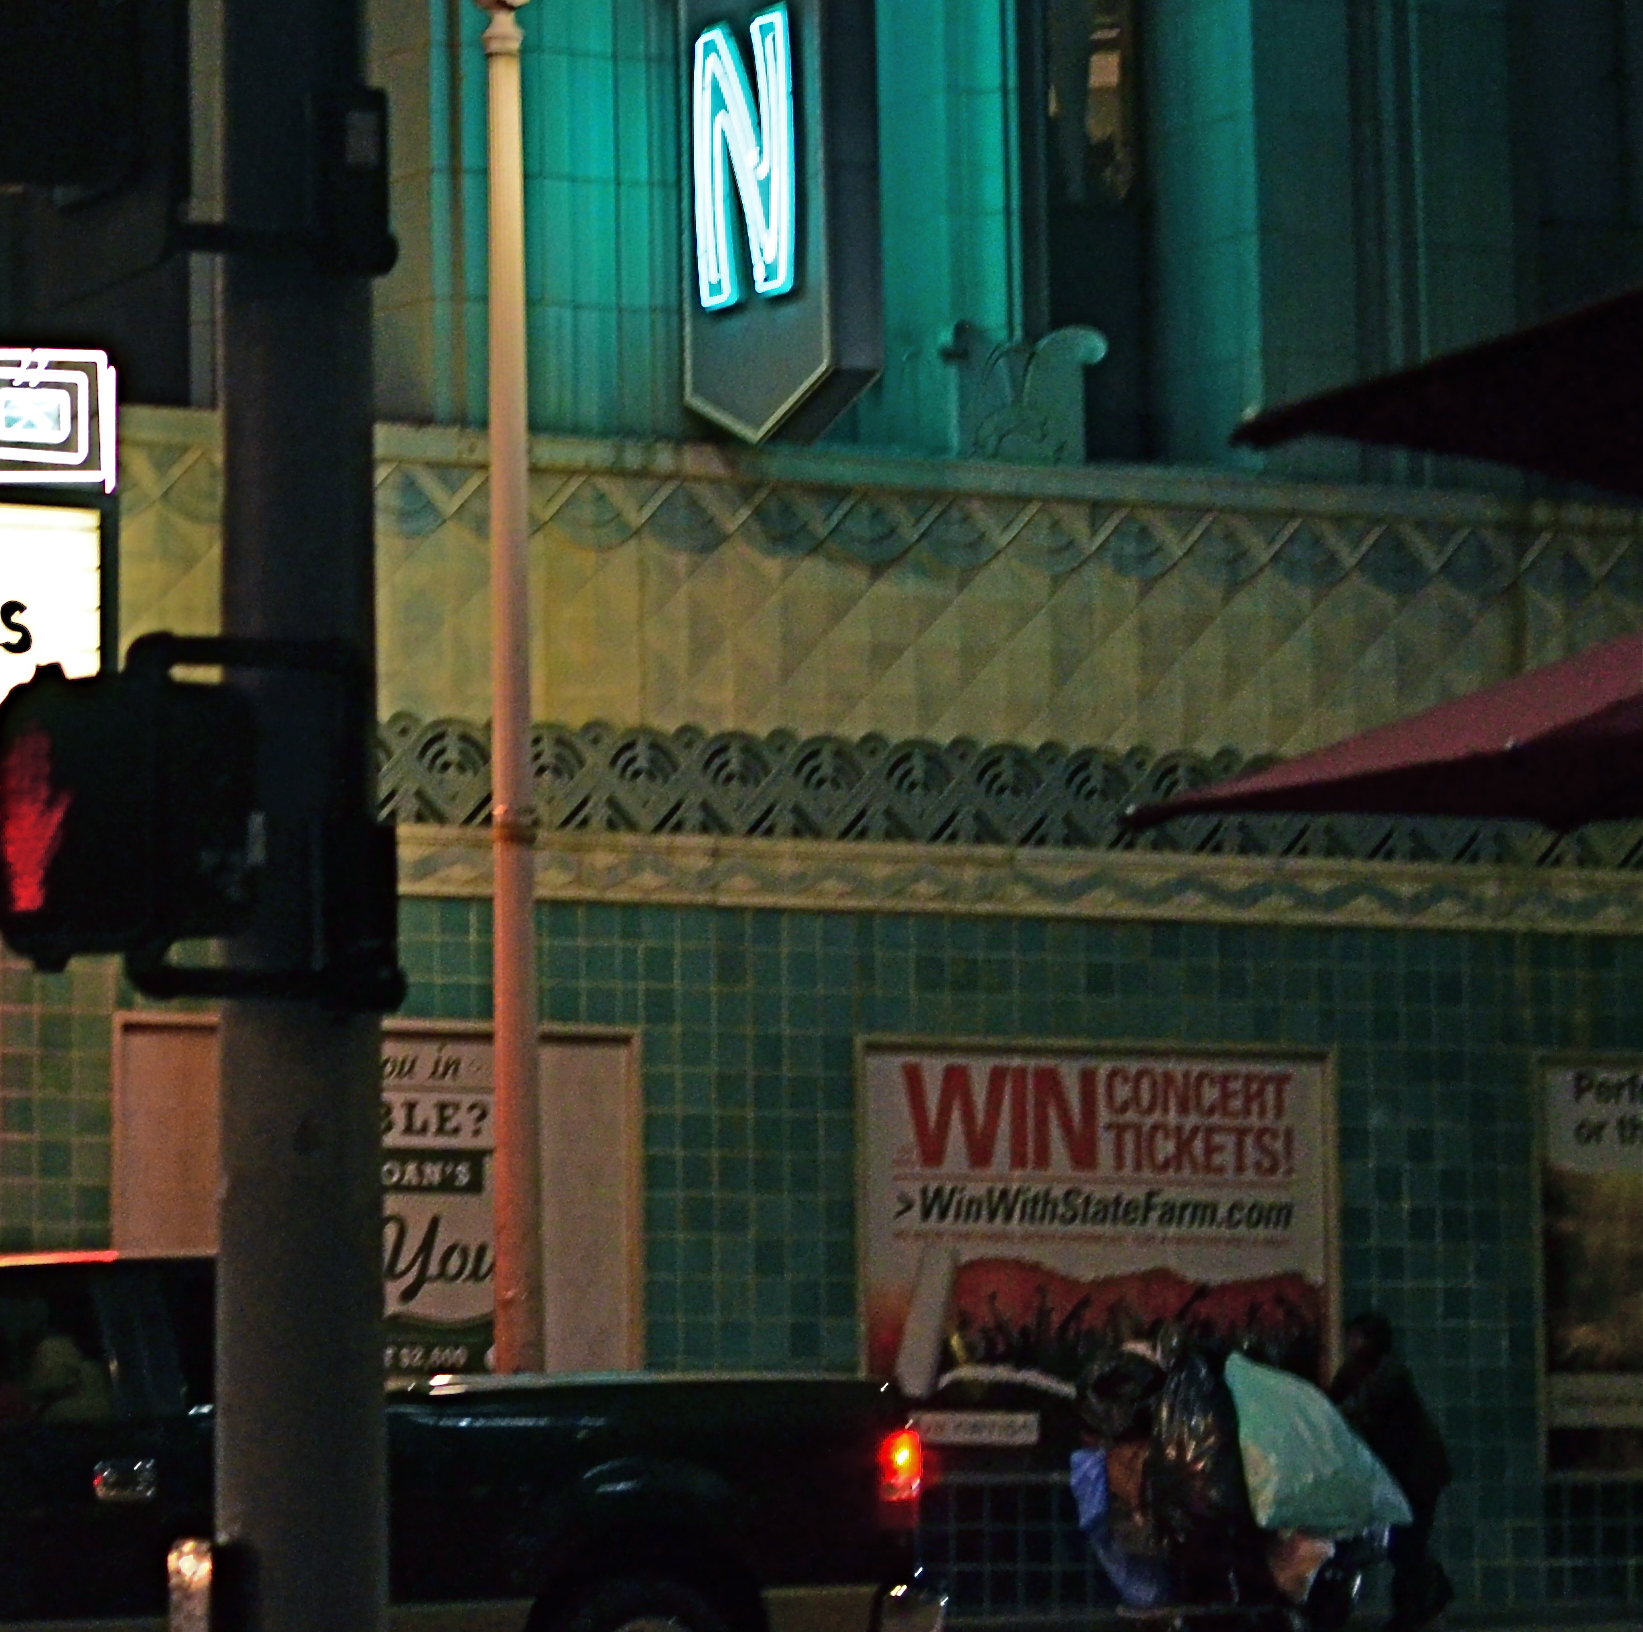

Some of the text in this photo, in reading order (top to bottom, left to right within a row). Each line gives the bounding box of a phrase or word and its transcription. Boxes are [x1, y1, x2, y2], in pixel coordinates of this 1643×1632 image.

[901, 1062, 1294, 1171] WIN CONCERT
[1102, 1120, 1295, 1178] TICKETS!
[920, 1184, 1295, 1231] WinWithStateFarm.com
